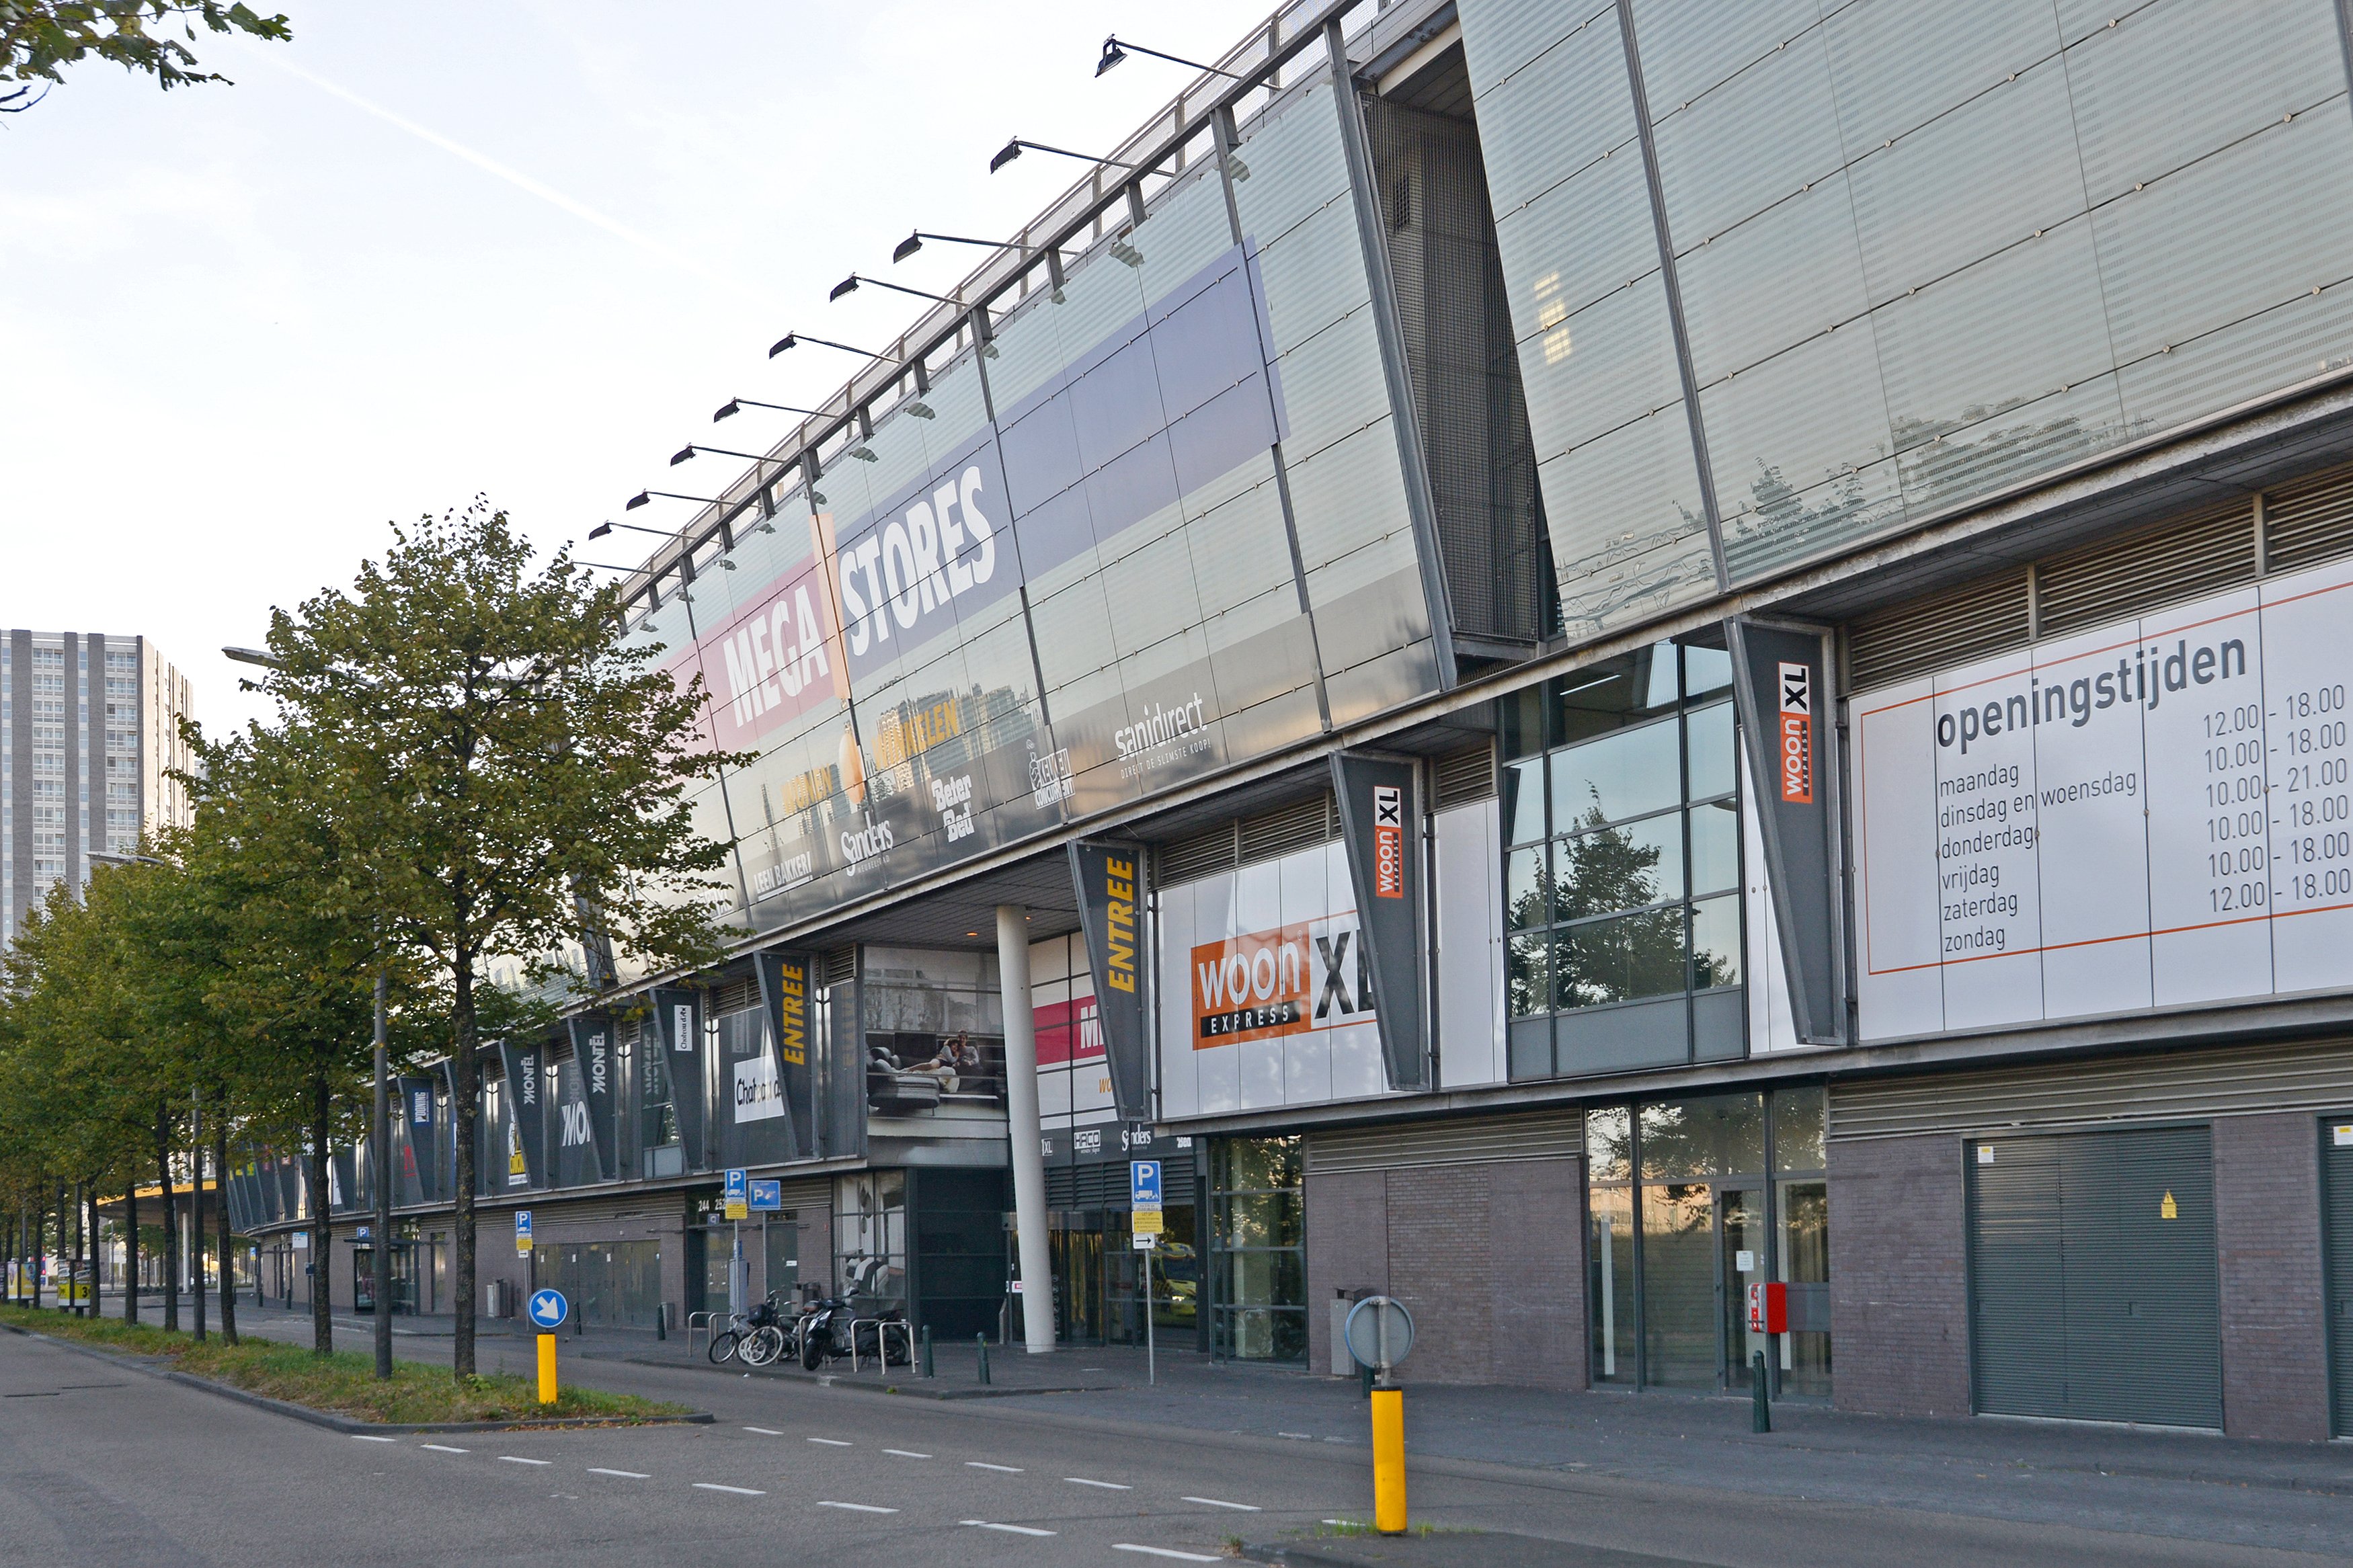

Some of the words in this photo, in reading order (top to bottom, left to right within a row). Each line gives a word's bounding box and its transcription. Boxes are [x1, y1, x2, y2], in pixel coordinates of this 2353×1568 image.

[723, 583, 828, 728] MEGA
[840, 466, 996, 657] STORES
[1784, 667, 1807, 712] XL
[1938, 638, 2245, 755] openingstijden
[871, 698, 959, 772] WINKELEN
[1115, 692, 1207, 761] sanidirect
[1785, 718, 1802, 796] woon
[1940, 764, 2019, 796] maandag
[2204, 704, 2258, 738] 12.00
[2286, 685, 2344, 720] 18.00
[1120, 762, 1144, 779] DIRECT
[1146, 758, 1154, 770] DE
[1158, 747, 1187, 766] SLIMSTE
[1190, 738, 1211, 754] KOOP!
[1941, 798, 2007, 828] dinsdag
[2013, 794, 2034, 813] en
[2041, 770, 2137, 807] woensdag
[2205, 739, 2260, 773] 10.00
[2288, 721, 2346, 755] 18.00
[931, 774, 972, 813] Beter
[943, 801, 975, 842] Bed
[1379, 790, 1398, 826] XL
[1942, 825, 2034, 859] donderdag
[2206, 775, 2261, 808] 10.00
[2288, 758, 2347, 792] 21.00
[841, 811, 893, 876] Sanders
[1379, 831, 1393, 893] woon
[1942, 863, 1999, 893] vrijdag
[2207, 811, 2262, 842] 10.00
[2290, 794, 2348, 828] 18.00
[754, 867, 775, 894] LEEN
[1944, 891, 2018, 921] zaterdag
[2208, 846, 2264, 877] 10.00
[2291, 831, 2349, 864] 18.00
[1107, 856, 1135, 993] ENTREE
[1945, 925, 2005, 952] zondag
[2210, 881, 2265, 913] 12.00
[2292, 868, 2350, 900] 18.00
[1198, 942, 1300, 1009] woon
[782, 963, 805, 1065] ENTREE
[1211, 1005, 1289, 1034] EXPRESS
[520, 1055, 535, 1104] MONTËL
[589, 1032, 606, 1094] MONTËL
[736, 1077, 772, 1106] Chateau
[1074, 1130, 1101, 1149] HACO
[1121, 1124, 1151, 1151] Snders
[729, 1171, 742, 1186] P
[754, 1189, 764, 1202] P
[1138, 1164, 1154, 1186] P
[360, 1229, 366, 1237] P
[519, 1213, 528, 1225] P
